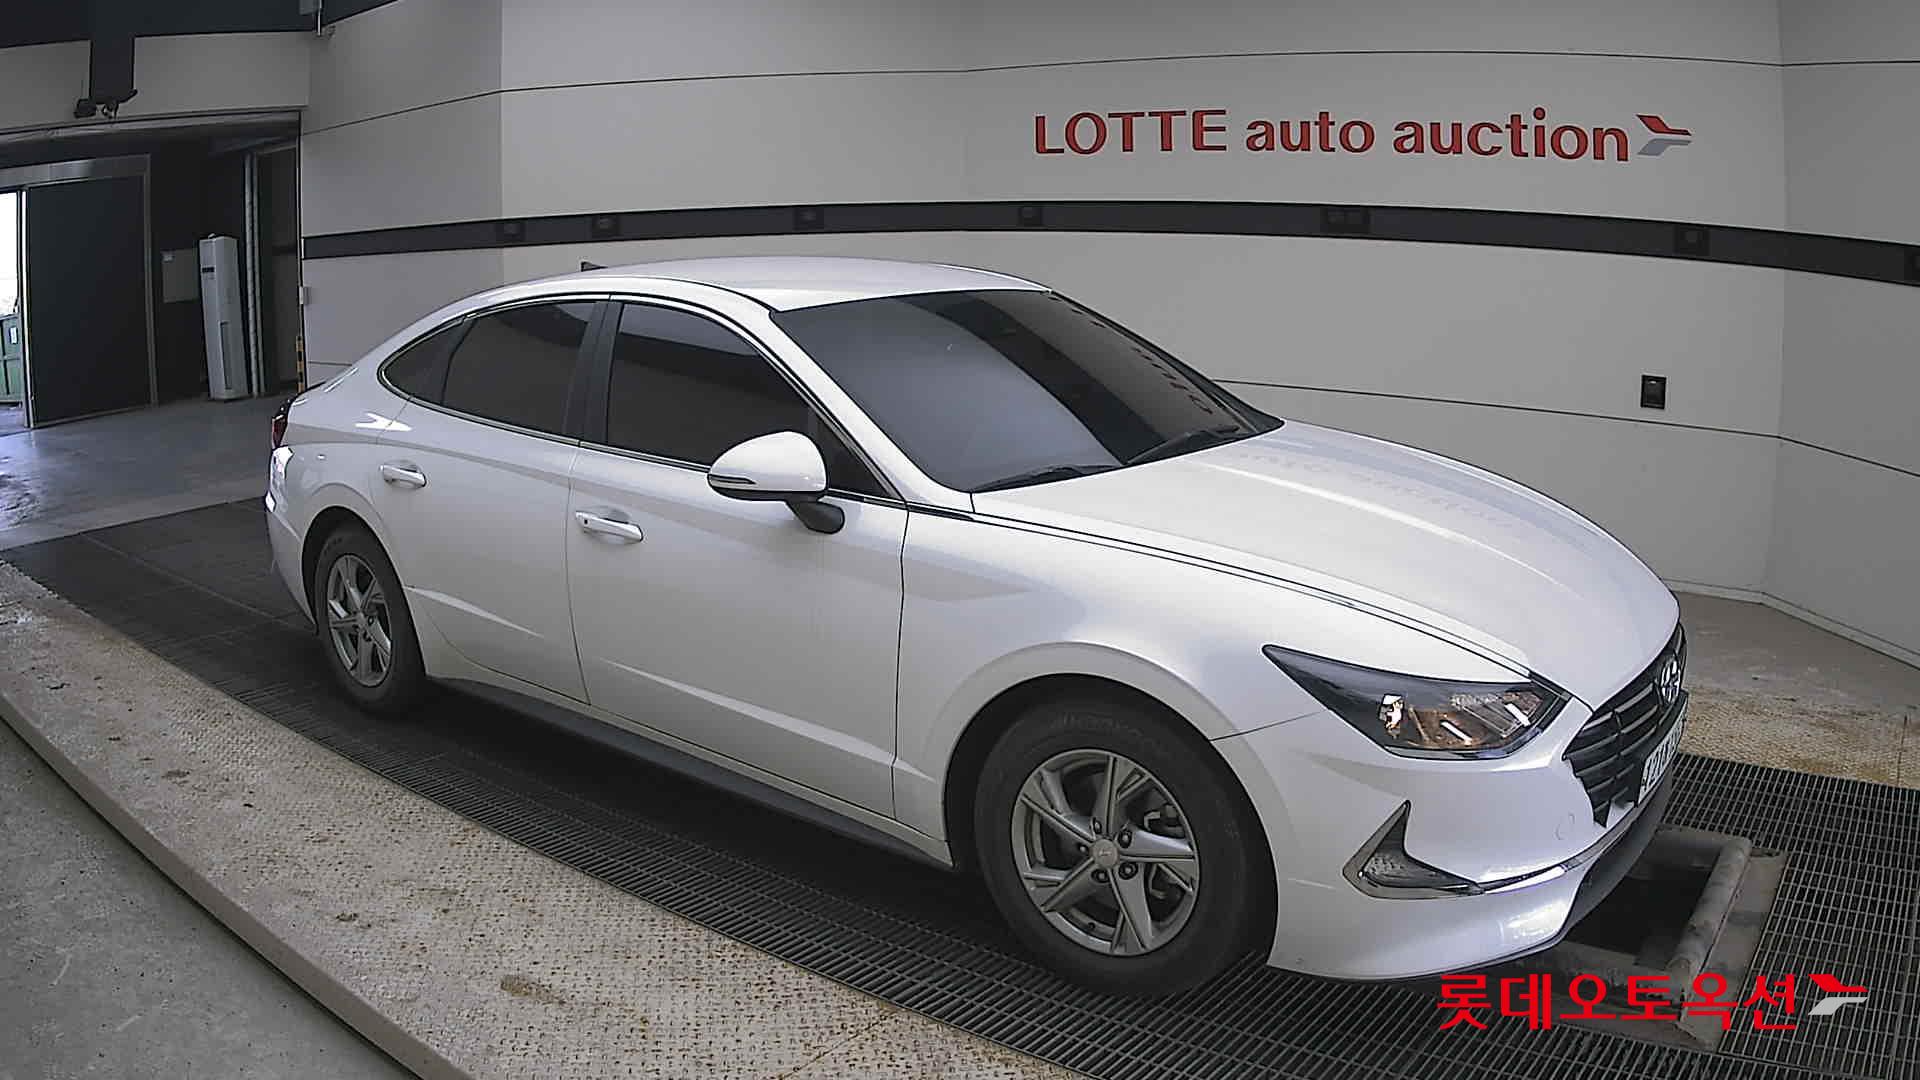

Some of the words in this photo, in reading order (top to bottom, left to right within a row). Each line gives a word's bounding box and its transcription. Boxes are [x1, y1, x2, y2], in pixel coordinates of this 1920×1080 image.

[1035, 109, 1227, 154] LOTTE
[1245, 111, 1375, 153] auto
[1394, 108, 1629, 161] auction
